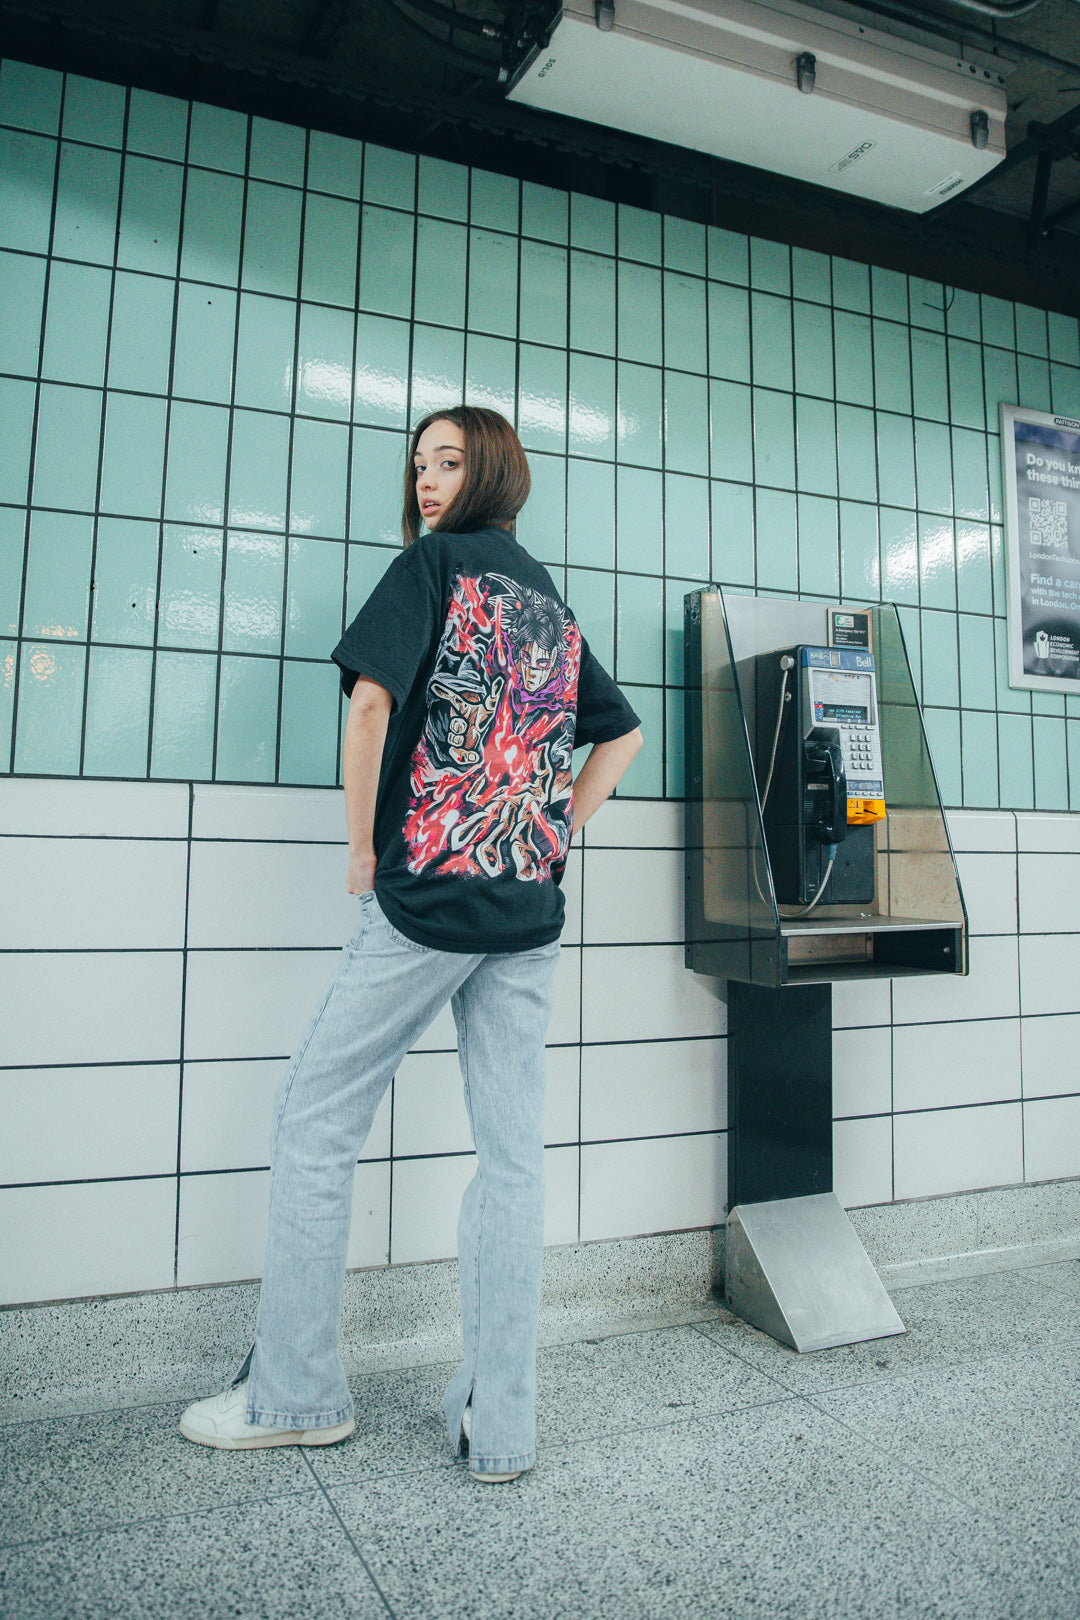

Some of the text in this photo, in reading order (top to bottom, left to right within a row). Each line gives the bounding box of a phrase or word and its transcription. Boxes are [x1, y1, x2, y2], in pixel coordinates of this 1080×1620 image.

[848, 141, 873, 160] DAS
[1026, 452, 1080, 475] Do you kn
[1026, 468, 1059, 485] these
[1031, 573, 1080, 589] Find a car
[1031, 587, 1047, 596] with
[1049, 589, 1061, 598] the
[1032, 597, 1040, 605] in
[855, 655, 872, 667] Bell
